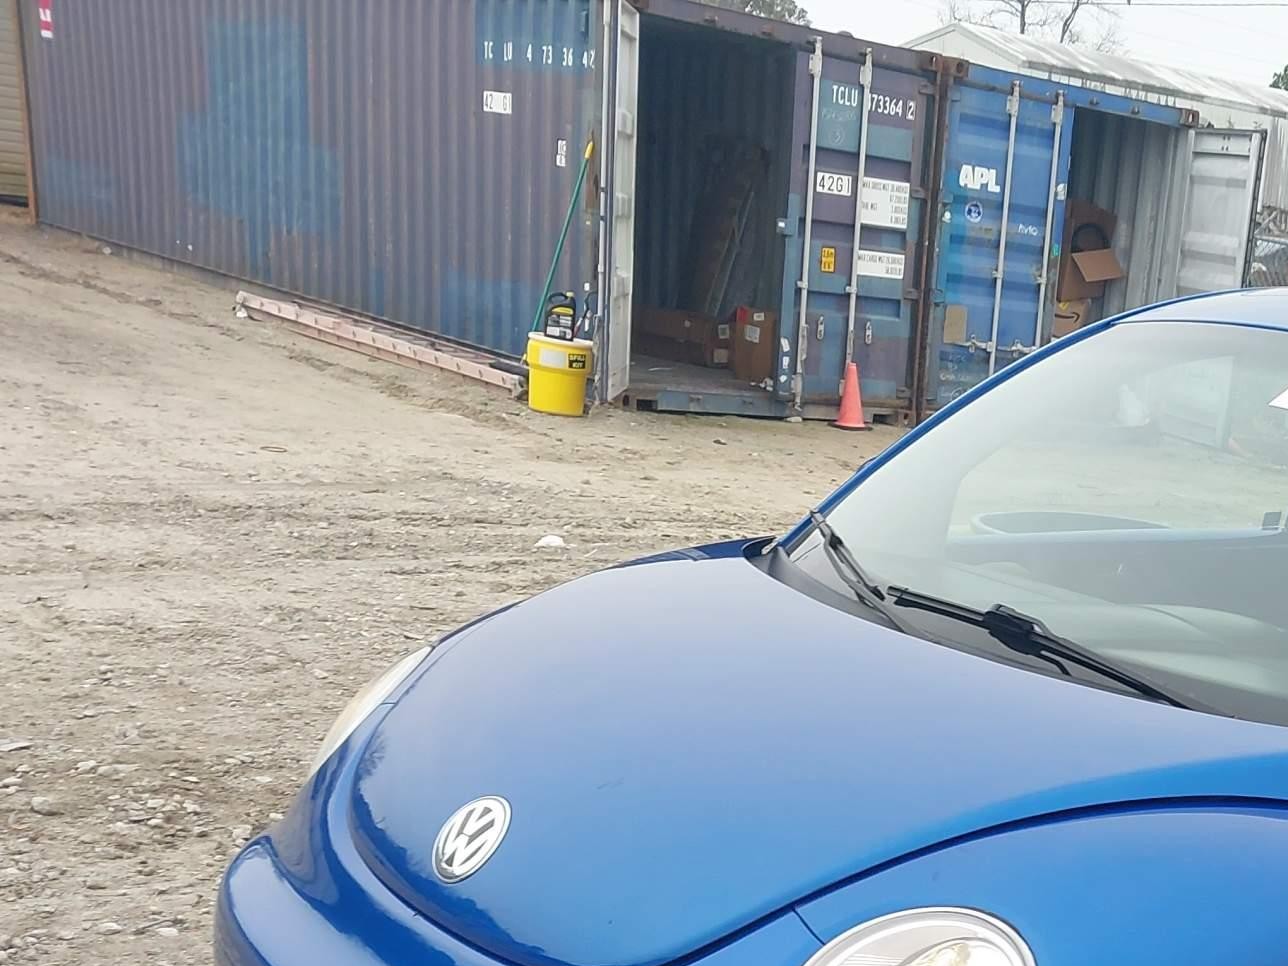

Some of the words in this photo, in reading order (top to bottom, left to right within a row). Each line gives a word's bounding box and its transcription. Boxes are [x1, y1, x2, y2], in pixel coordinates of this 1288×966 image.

[832, 85, 859, 107] TCLU
[818, 174, 851, 194] 42G1
[959, 164, 1001, 192] APL
